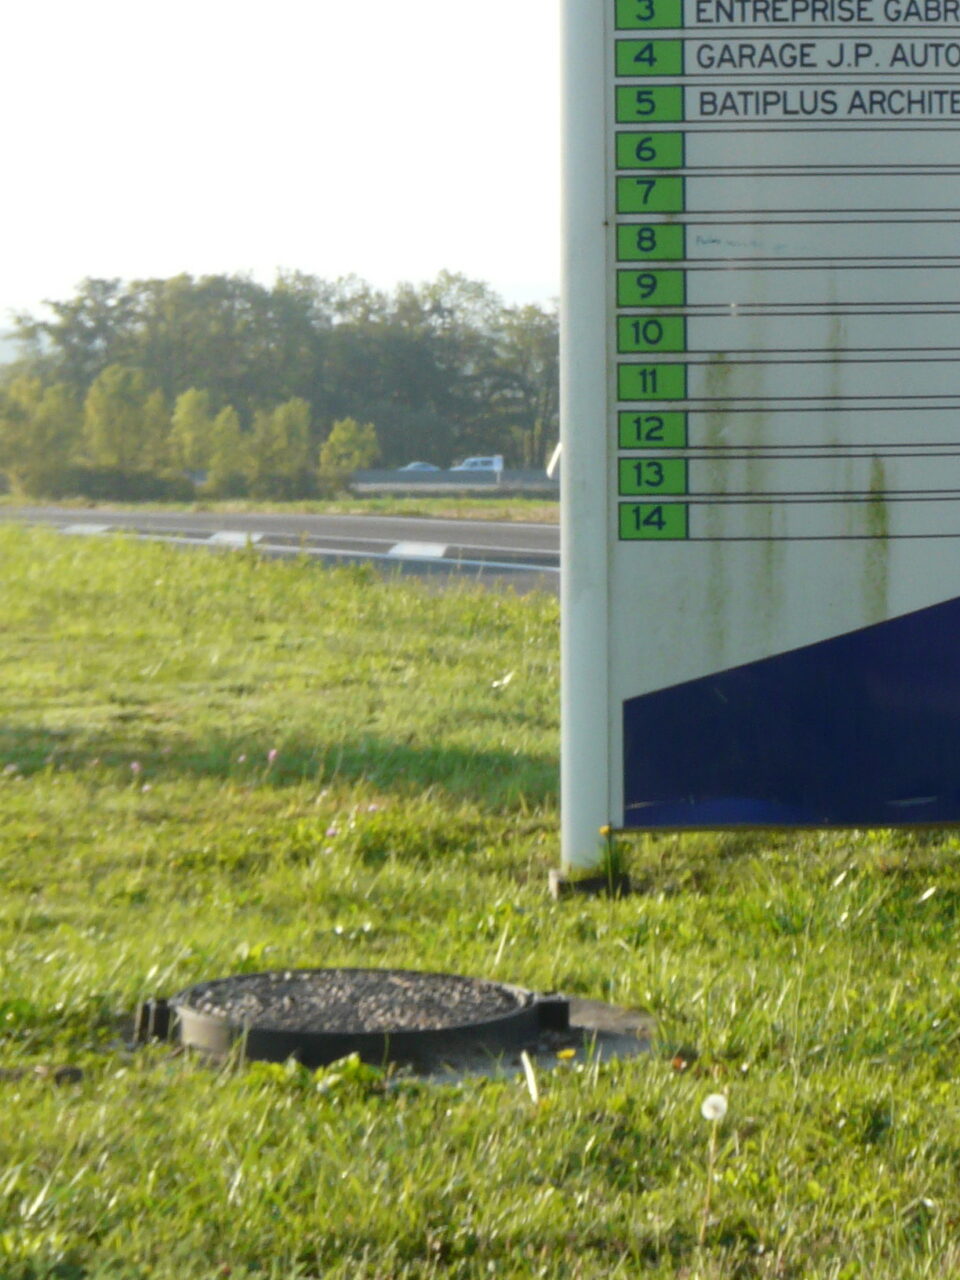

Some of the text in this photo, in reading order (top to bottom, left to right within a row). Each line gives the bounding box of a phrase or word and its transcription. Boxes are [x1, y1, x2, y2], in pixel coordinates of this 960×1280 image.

[633, 43, 657, 66] 4
[696, 42, 817, 69] GARAGE
[827, 43, 879, 68] J.P.
[636, 90, 656, 115] 5
[699, 89, 838, 115] BATIPLUS
[636, 136, 657, 162] 6
[636, 180, 656, 204] 7
[636, 225, 657, 252] 8
[636, 273, 657, 299] 9
[632, 320, 663, 345] 10
[639, 368, 658, 393] 11
[633, 415, 664, 442] 12
[633, 462, 664, 487] 13
[632, 506, 666, 532] 14
